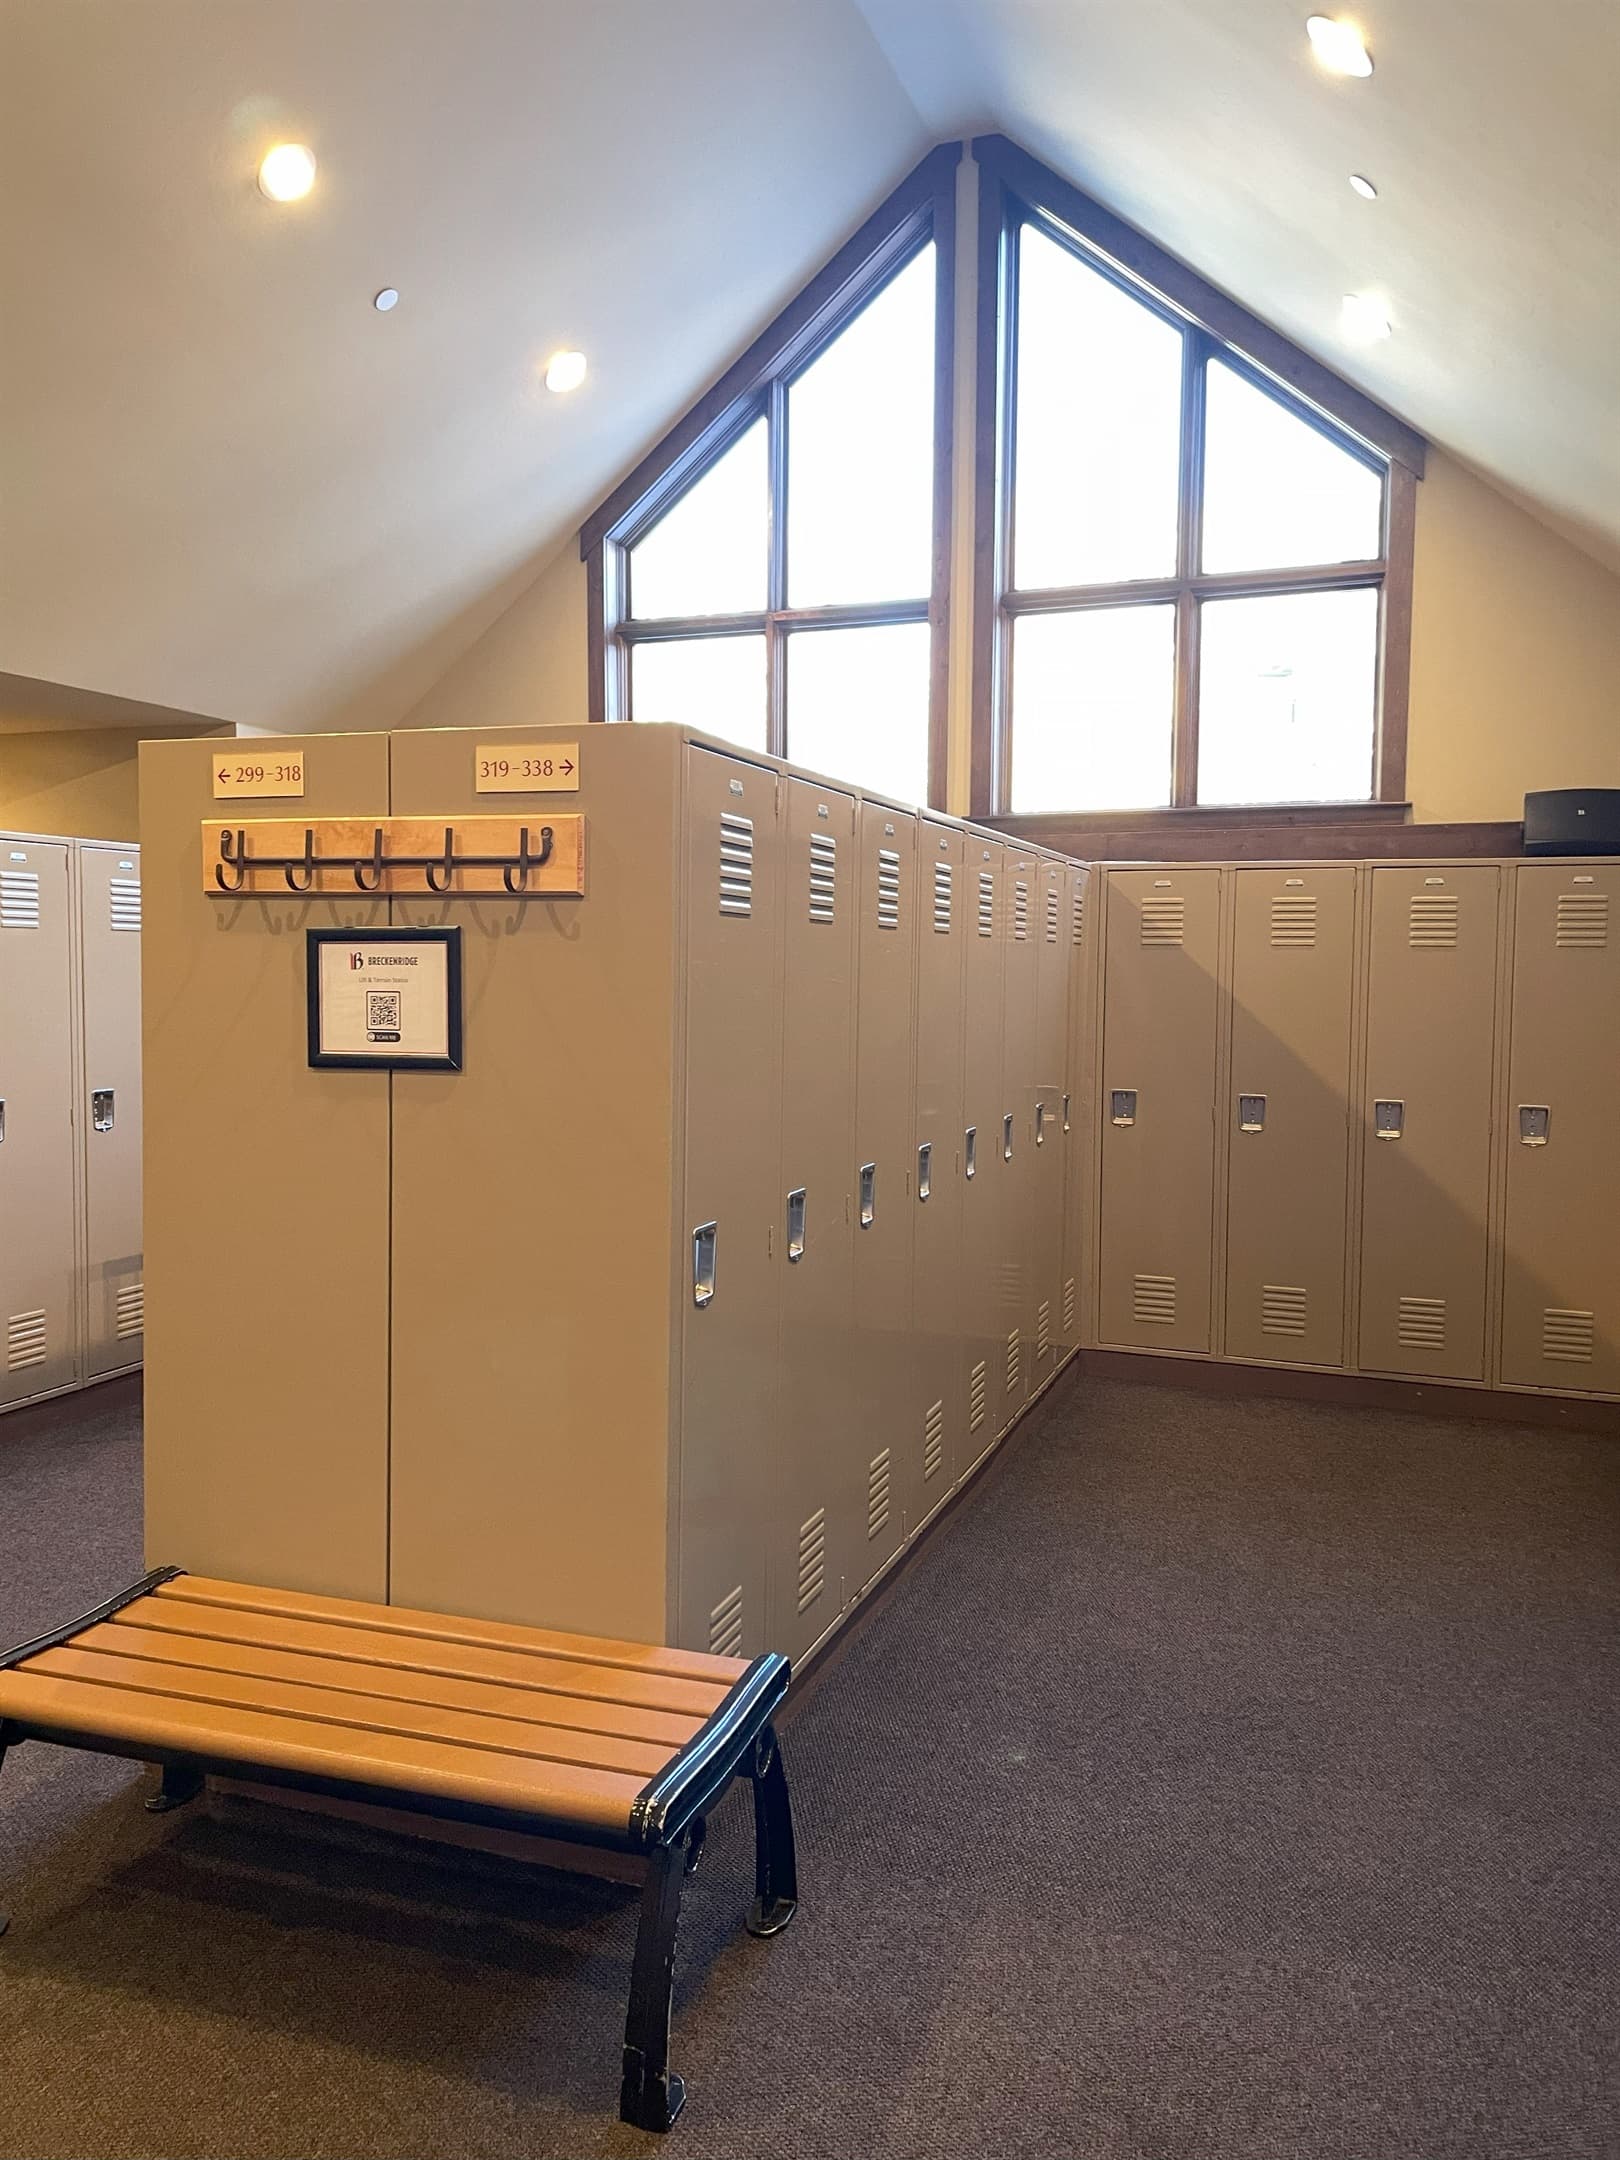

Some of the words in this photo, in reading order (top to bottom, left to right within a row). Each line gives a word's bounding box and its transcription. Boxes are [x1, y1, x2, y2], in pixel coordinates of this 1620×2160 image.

[236, 765, 301, 783] 299-318
[480, 759, 554, 778] 319-338
[367, 956, 419, 966] BRECKENRIDGE
